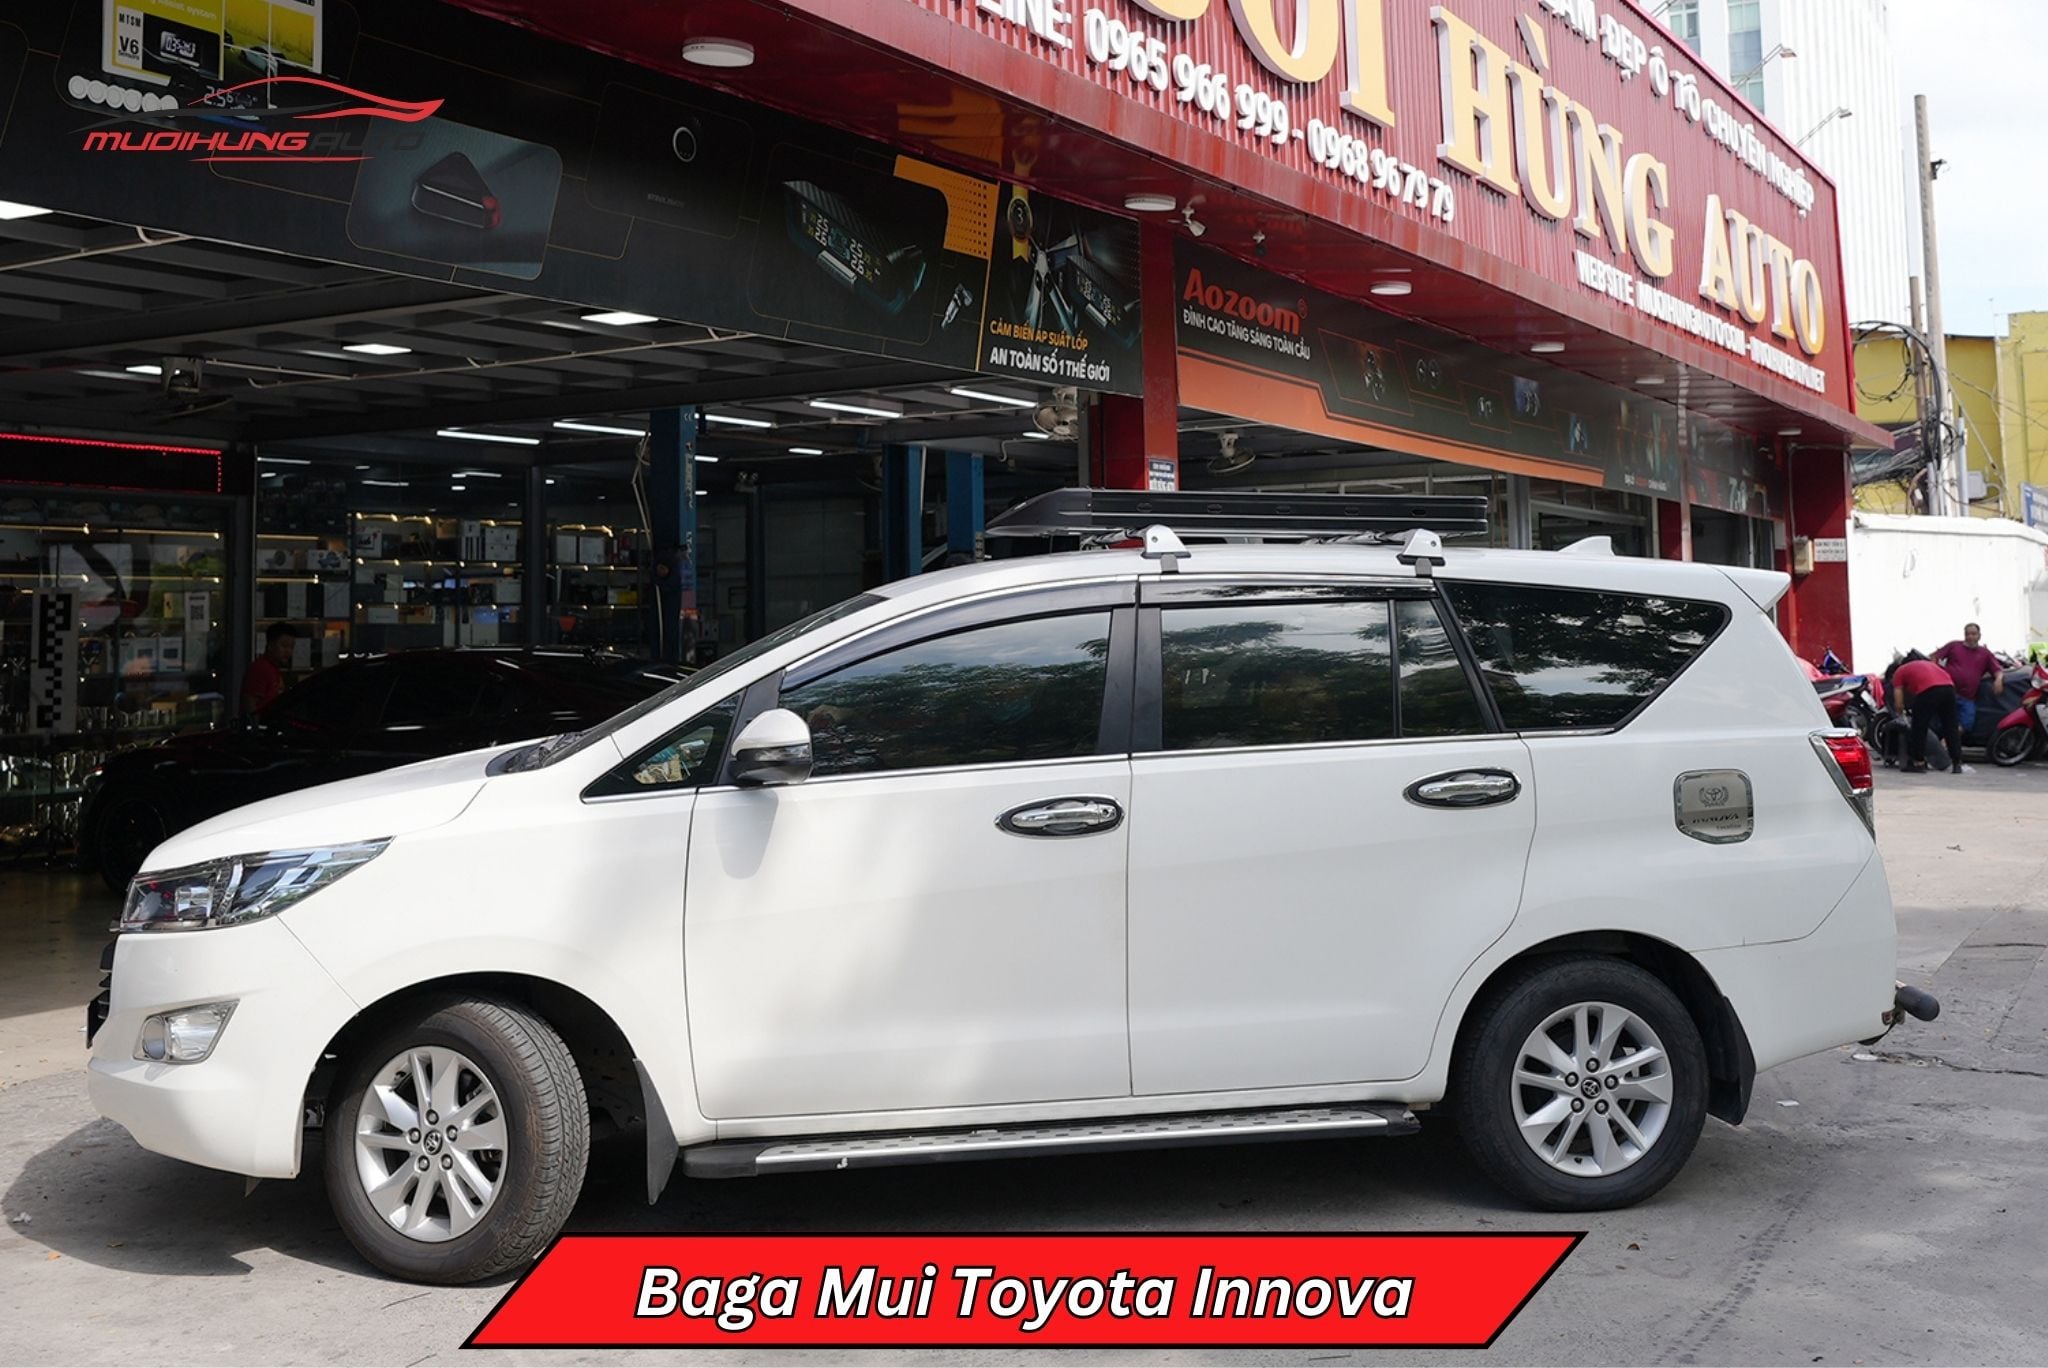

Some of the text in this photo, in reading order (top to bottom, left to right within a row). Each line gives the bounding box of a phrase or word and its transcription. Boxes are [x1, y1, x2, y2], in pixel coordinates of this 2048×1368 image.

[119, 35, 140, 55] V6
[1084, 8, 1168, 92] 0965
[1173, 54, 1232, 120] 966
[1235, 83, 1290, 144] 999
[1600, 13, 1648, 80] ĐẸP
[1649, 46, 1669, 96] Ô
[1669, 70, 1701, 122] TÔ
[1702, 98, 1767, 177] CHUYÊN
[1430, 5, 1675, 278] HÙNG
[1699, 193, 1825, 354] AUTO
[989, 346, 1110, 382] AN TOÀN SỐ 1 THẾ GIỚI
[1206, 316, 1226, 335] CAO
